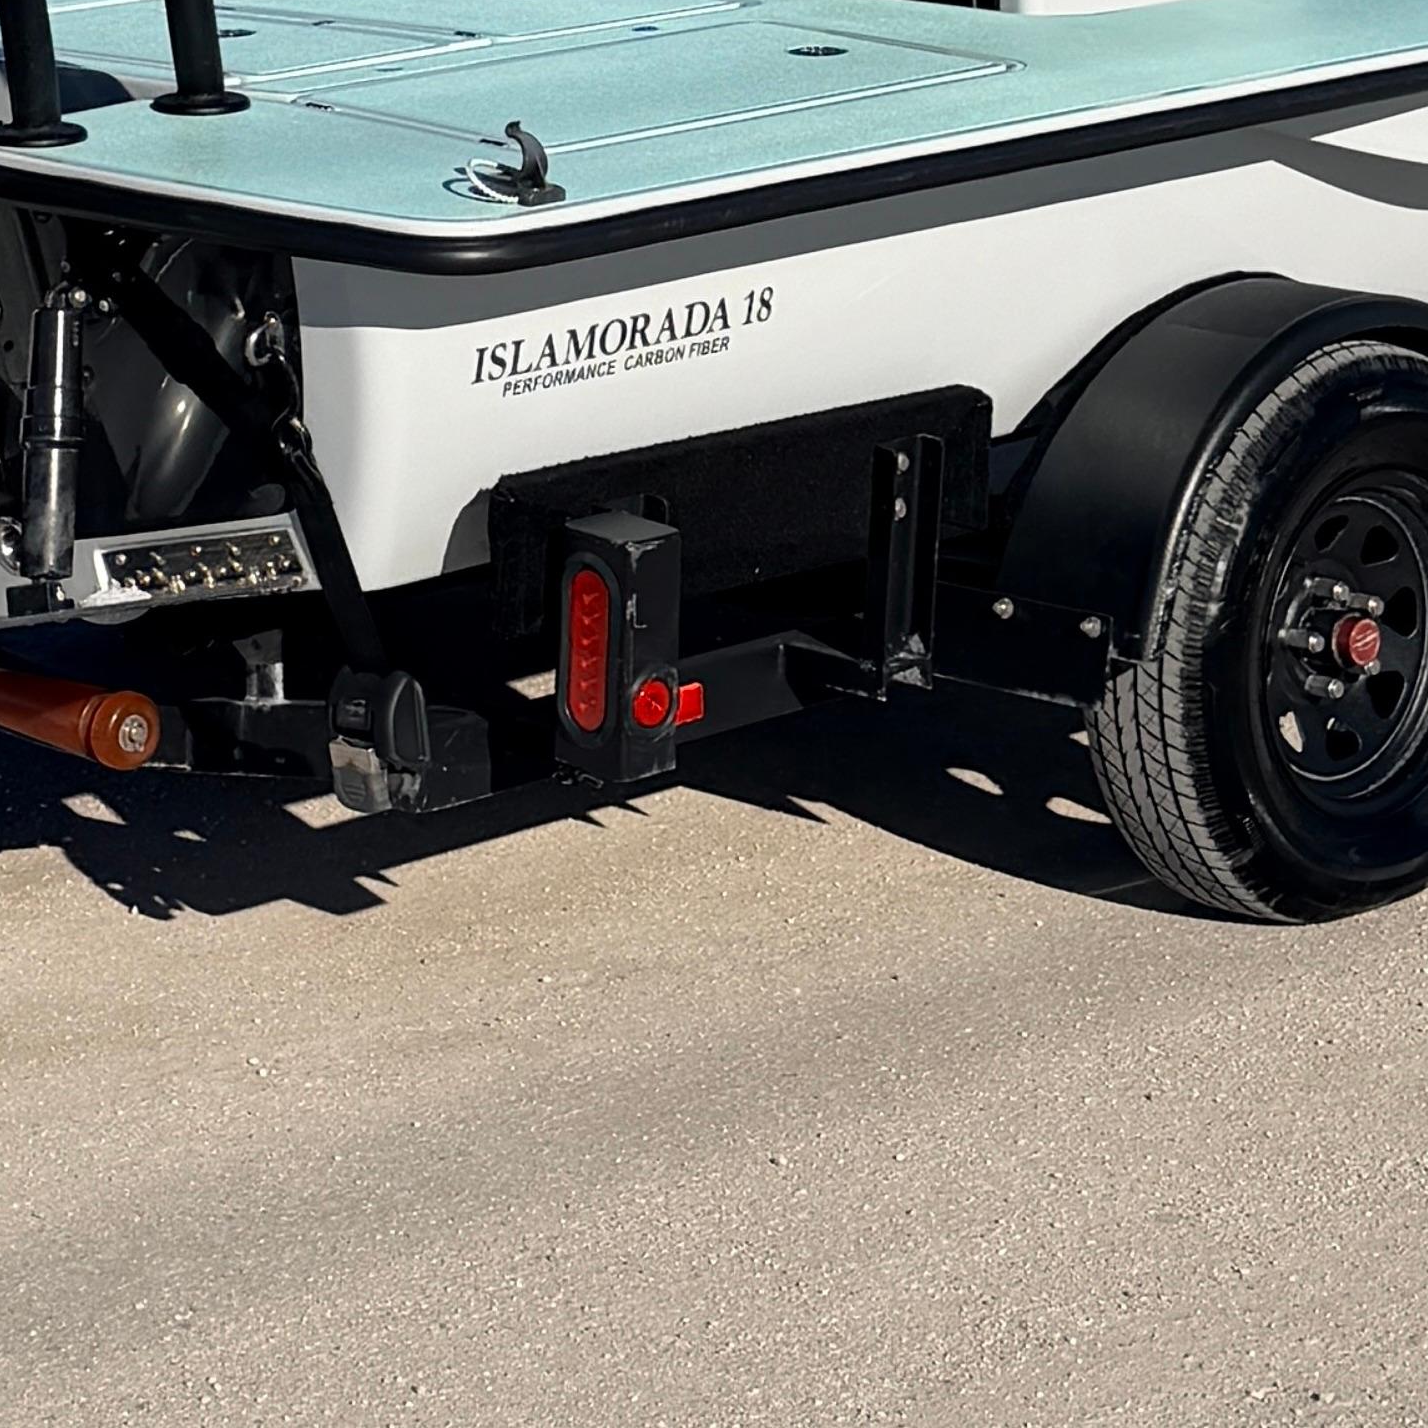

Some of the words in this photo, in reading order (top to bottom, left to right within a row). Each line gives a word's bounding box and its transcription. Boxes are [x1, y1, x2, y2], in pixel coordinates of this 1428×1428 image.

[471, 297, 731, 385] ISLAMORADA
[741, 285, 775, 326] 18
[501, 358, 617, 398] PERFORMANCE
[623, 344, 686, 373] CARBON
[689, 335, 731, 358] FIBER
